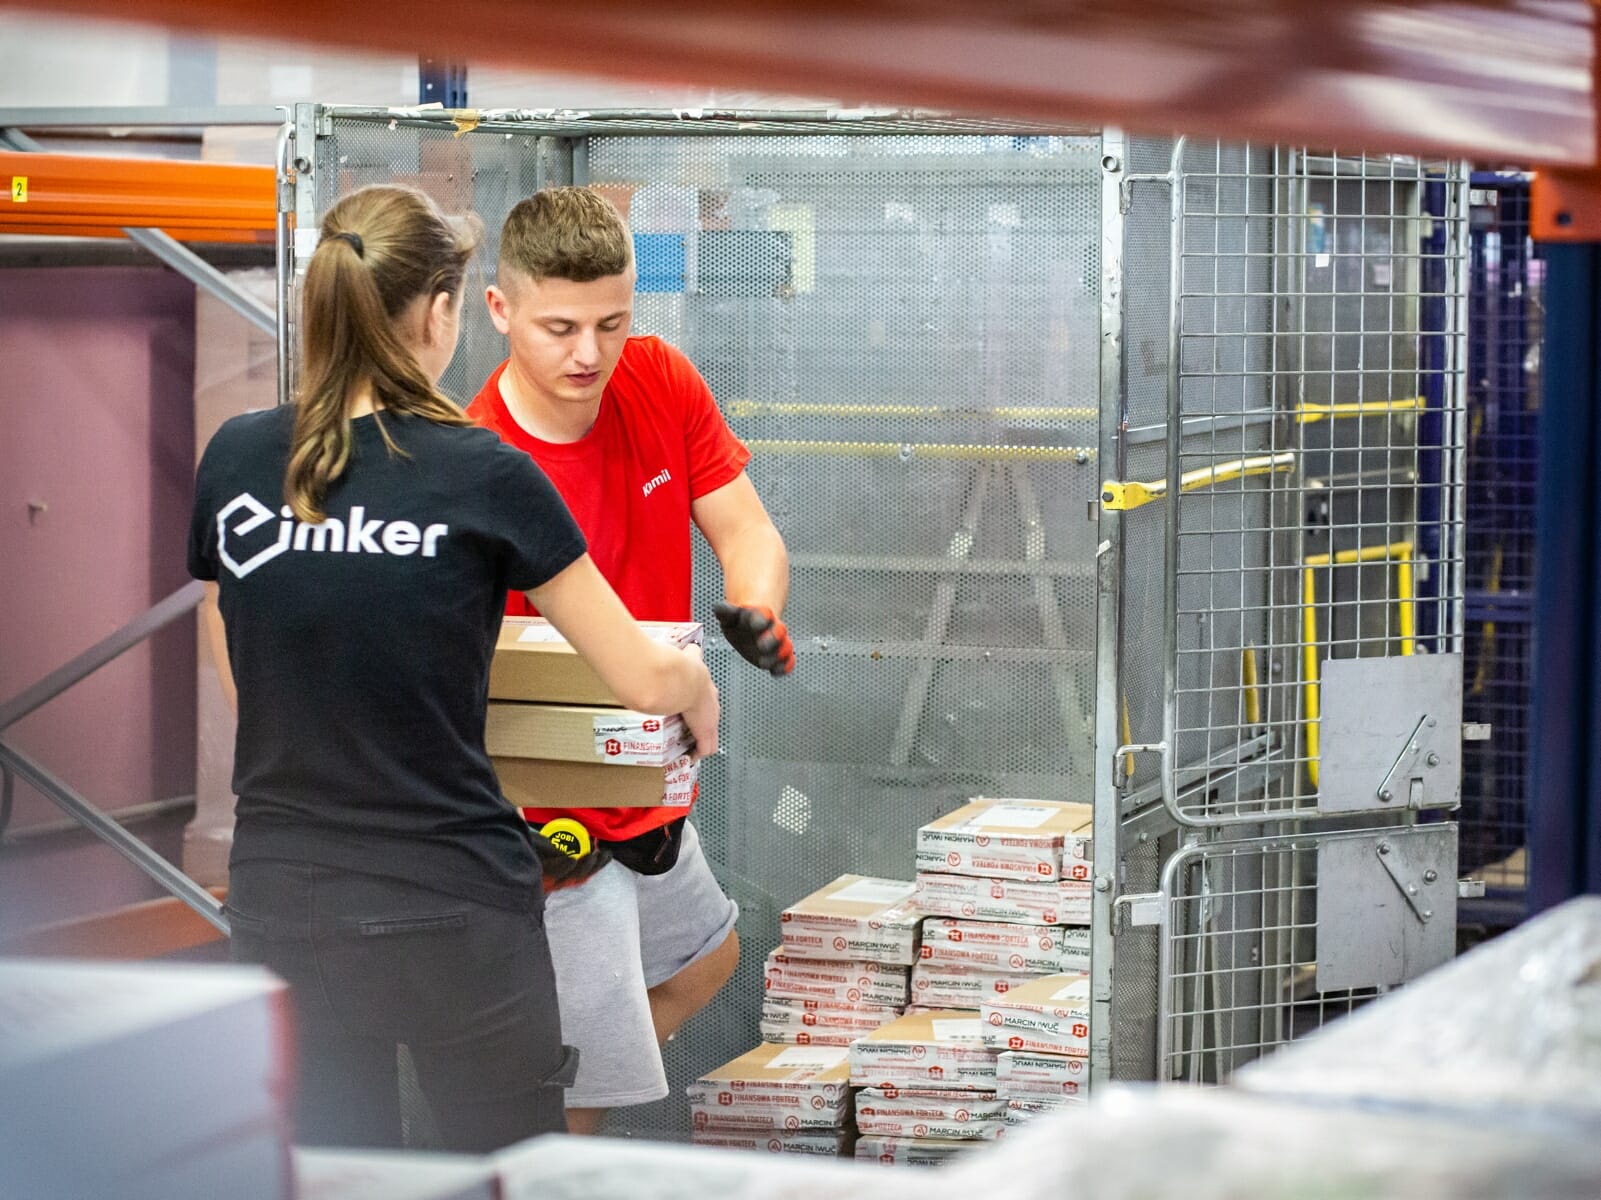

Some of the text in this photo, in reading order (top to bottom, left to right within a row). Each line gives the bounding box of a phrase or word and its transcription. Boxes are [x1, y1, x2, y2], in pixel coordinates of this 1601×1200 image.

[17, 182, 22, 196] 2
[669, 792, 690, 801] FORTE
[1004, 1016, 1036, 1027] MARCIN
[1064, 1044, 1088, 1054] FORTEC
[771, 1094, 800, 1105] FORTECA
[929, 1127, 960, 1136] MARCIN
[783, 1143, 814, 1152] MARCIN
